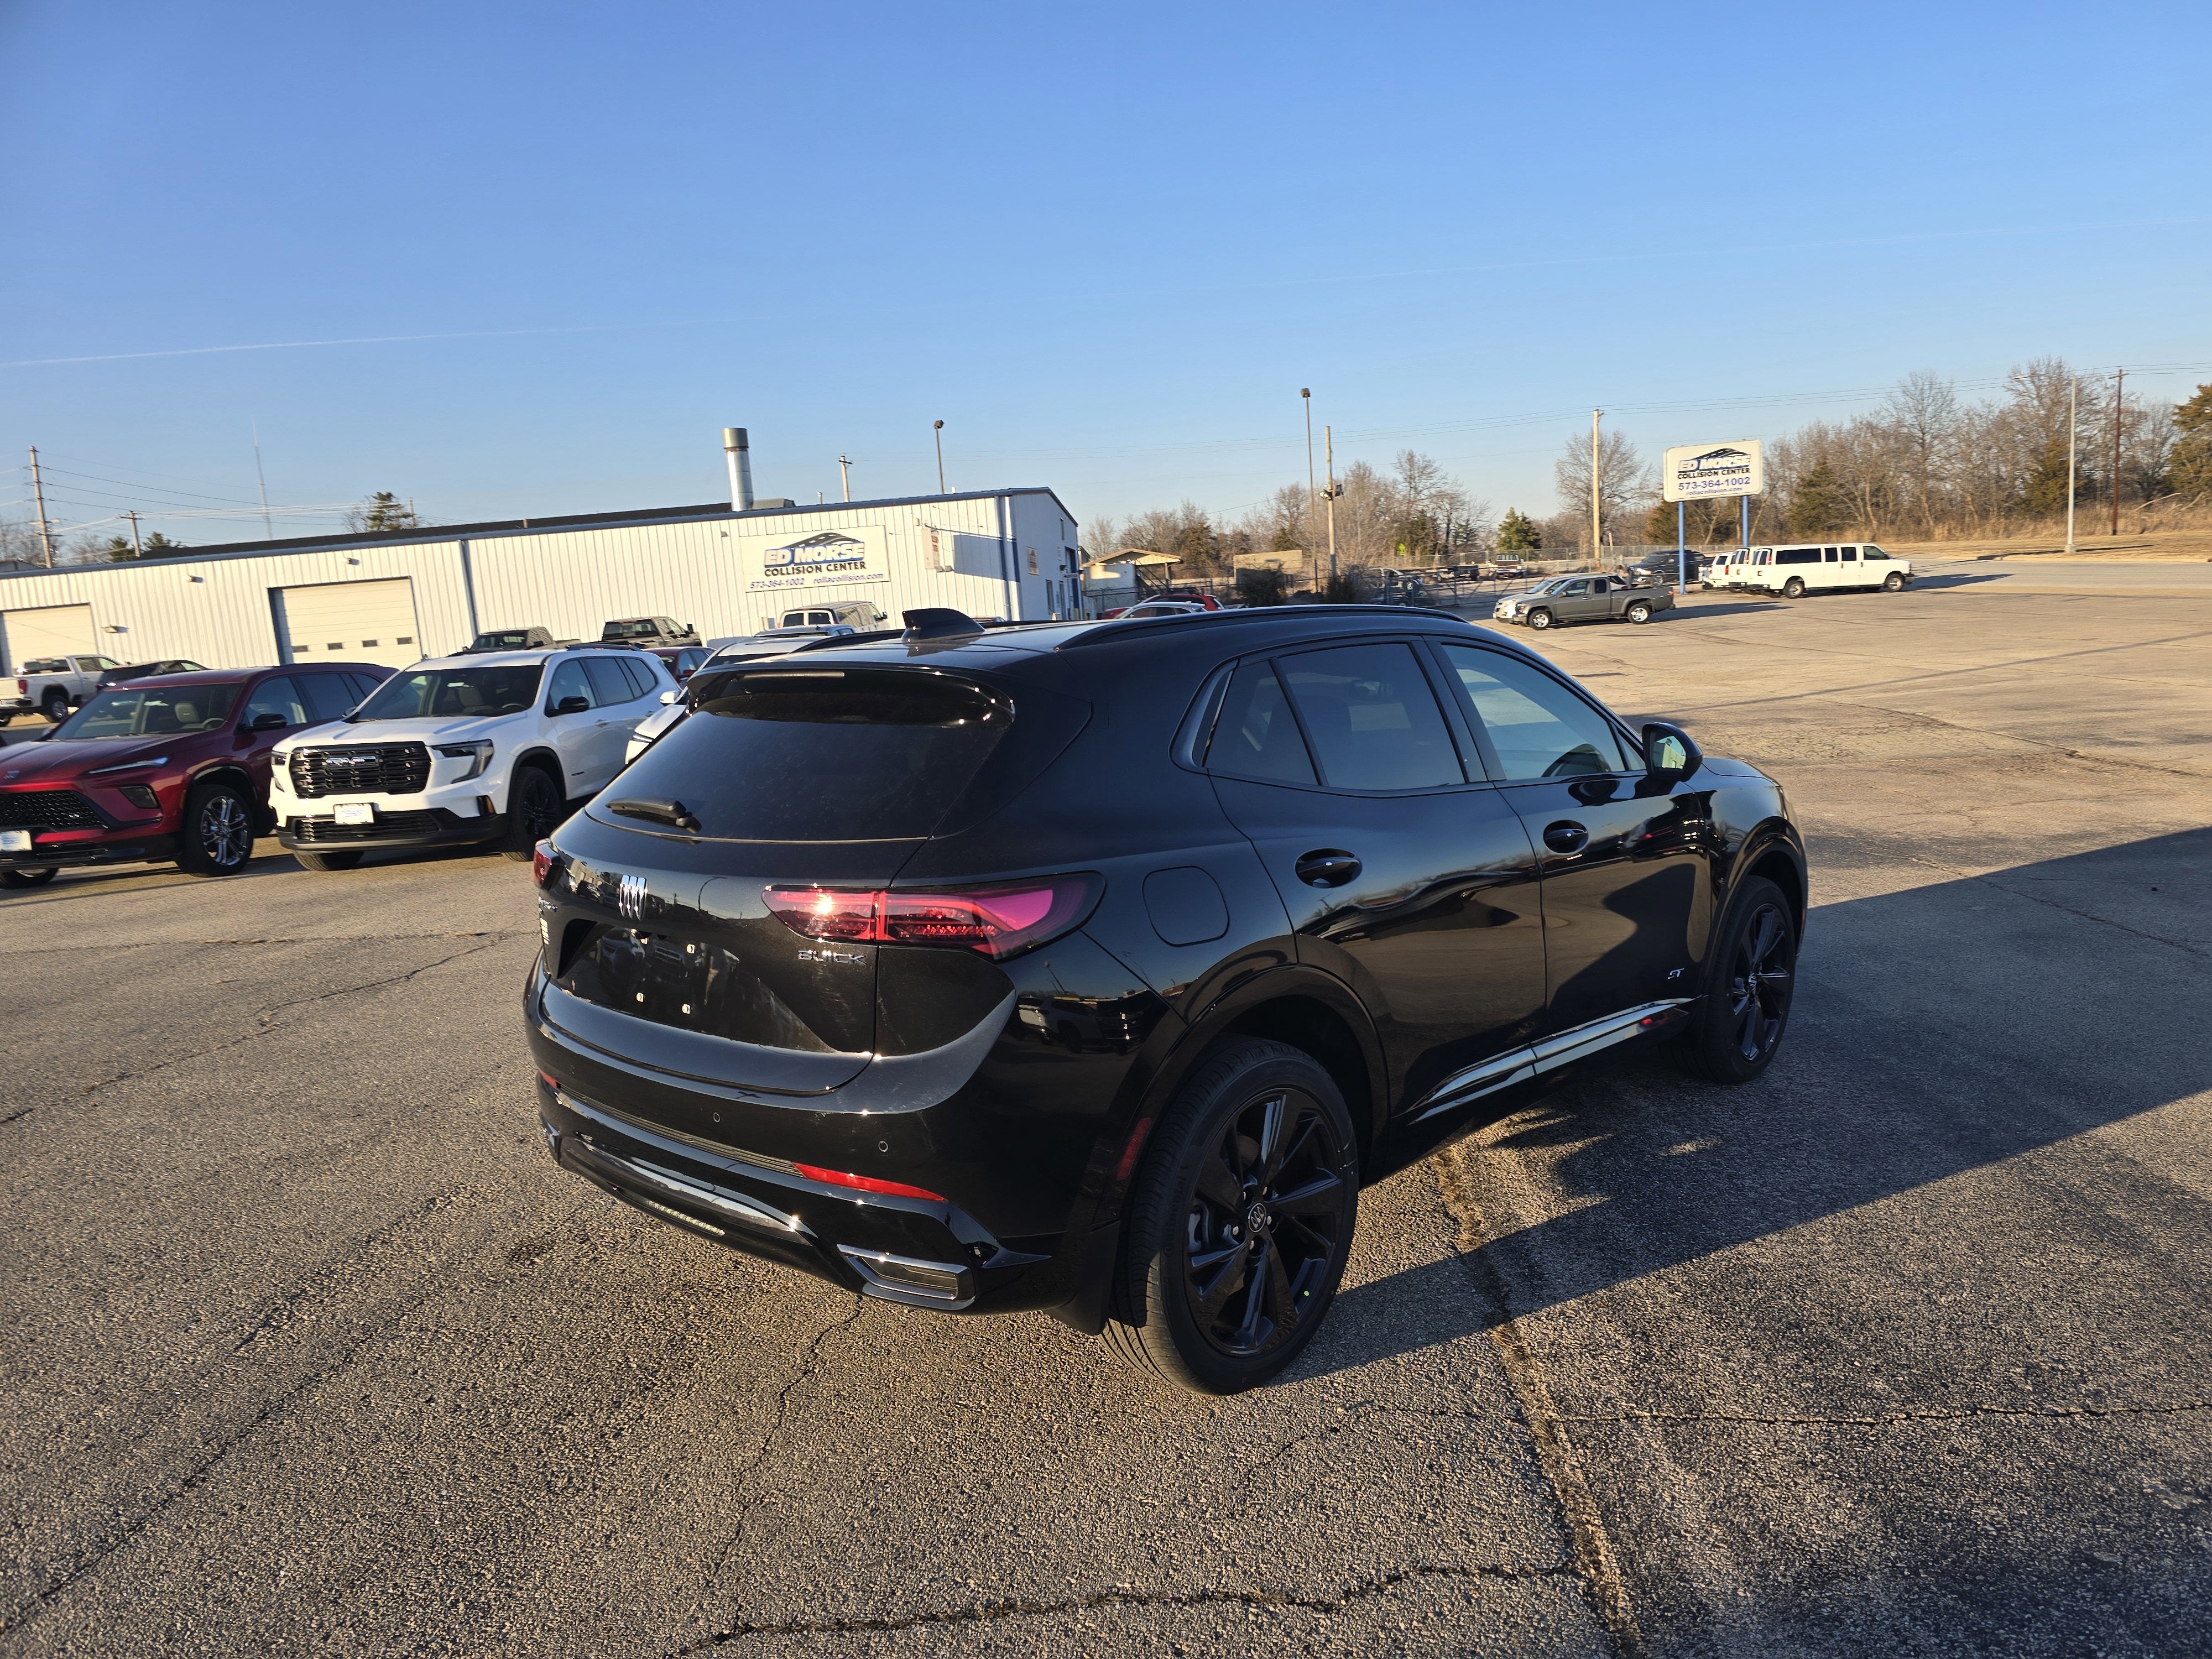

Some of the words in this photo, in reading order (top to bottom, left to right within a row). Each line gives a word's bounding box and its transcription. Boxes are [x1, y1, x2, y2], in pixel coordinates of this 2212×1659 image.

[1679, 460, 1699, 473] ED
[1699, 455, 1751, 470] MORSE
[1678, 471, 1718, 479] COLLISION
[1678, 477, 1750, 491] 573-364-1002
[765, 549, 792, 567] ED
[793, 542, 865, 564] MORSE
[764, 565, 823, 576] COLLISION
[826, 561, 867, 572] CENTER
[750, 578, 805, 589] 573-364-1002
[798, 950, 867, 965] BUICK
